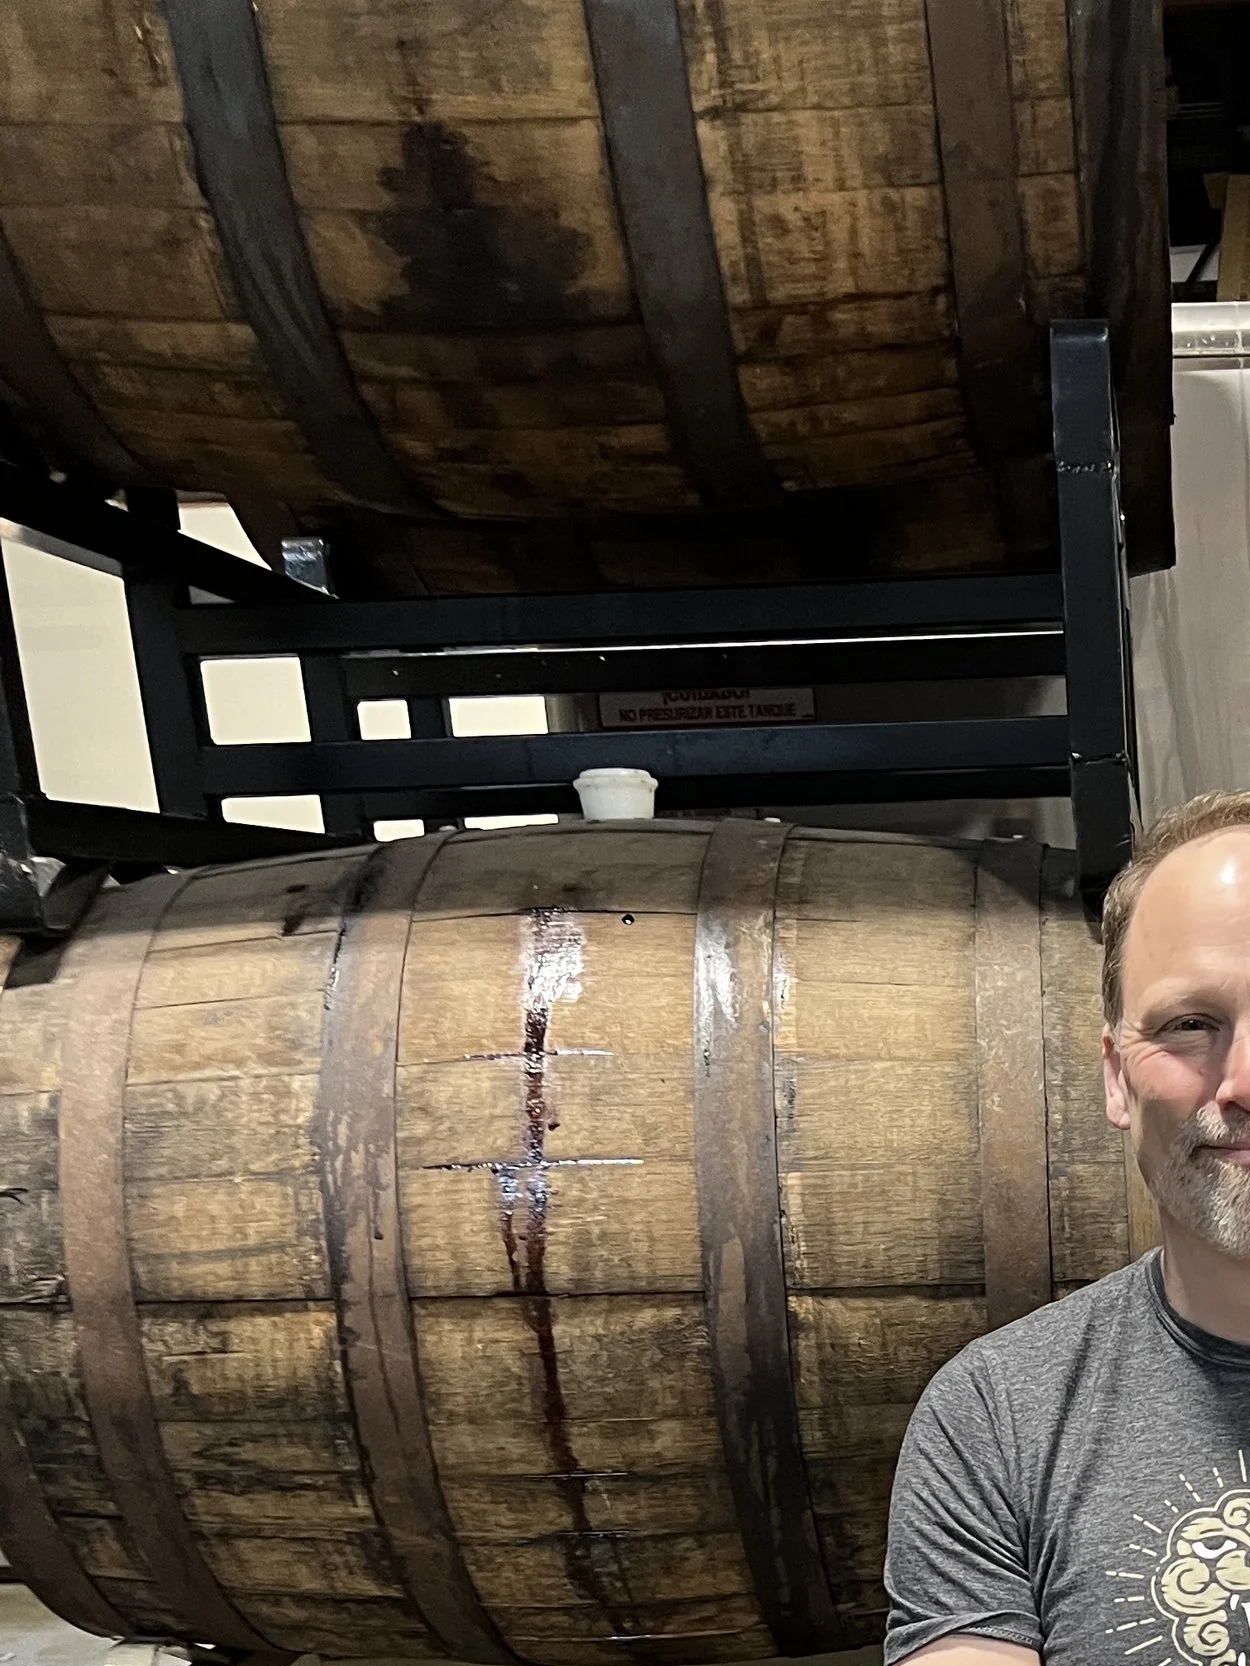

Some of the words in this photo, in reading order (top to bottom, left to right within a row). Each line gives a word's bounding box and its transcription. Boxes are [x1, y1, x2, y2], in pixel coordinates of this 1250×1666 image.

[619, 707, 636, 722] NO
[639, 705, 713, 722] PRESURIZAR
[716, 704, 745, 720] ESTE
[749, 702, 796, 719] TANQUE
